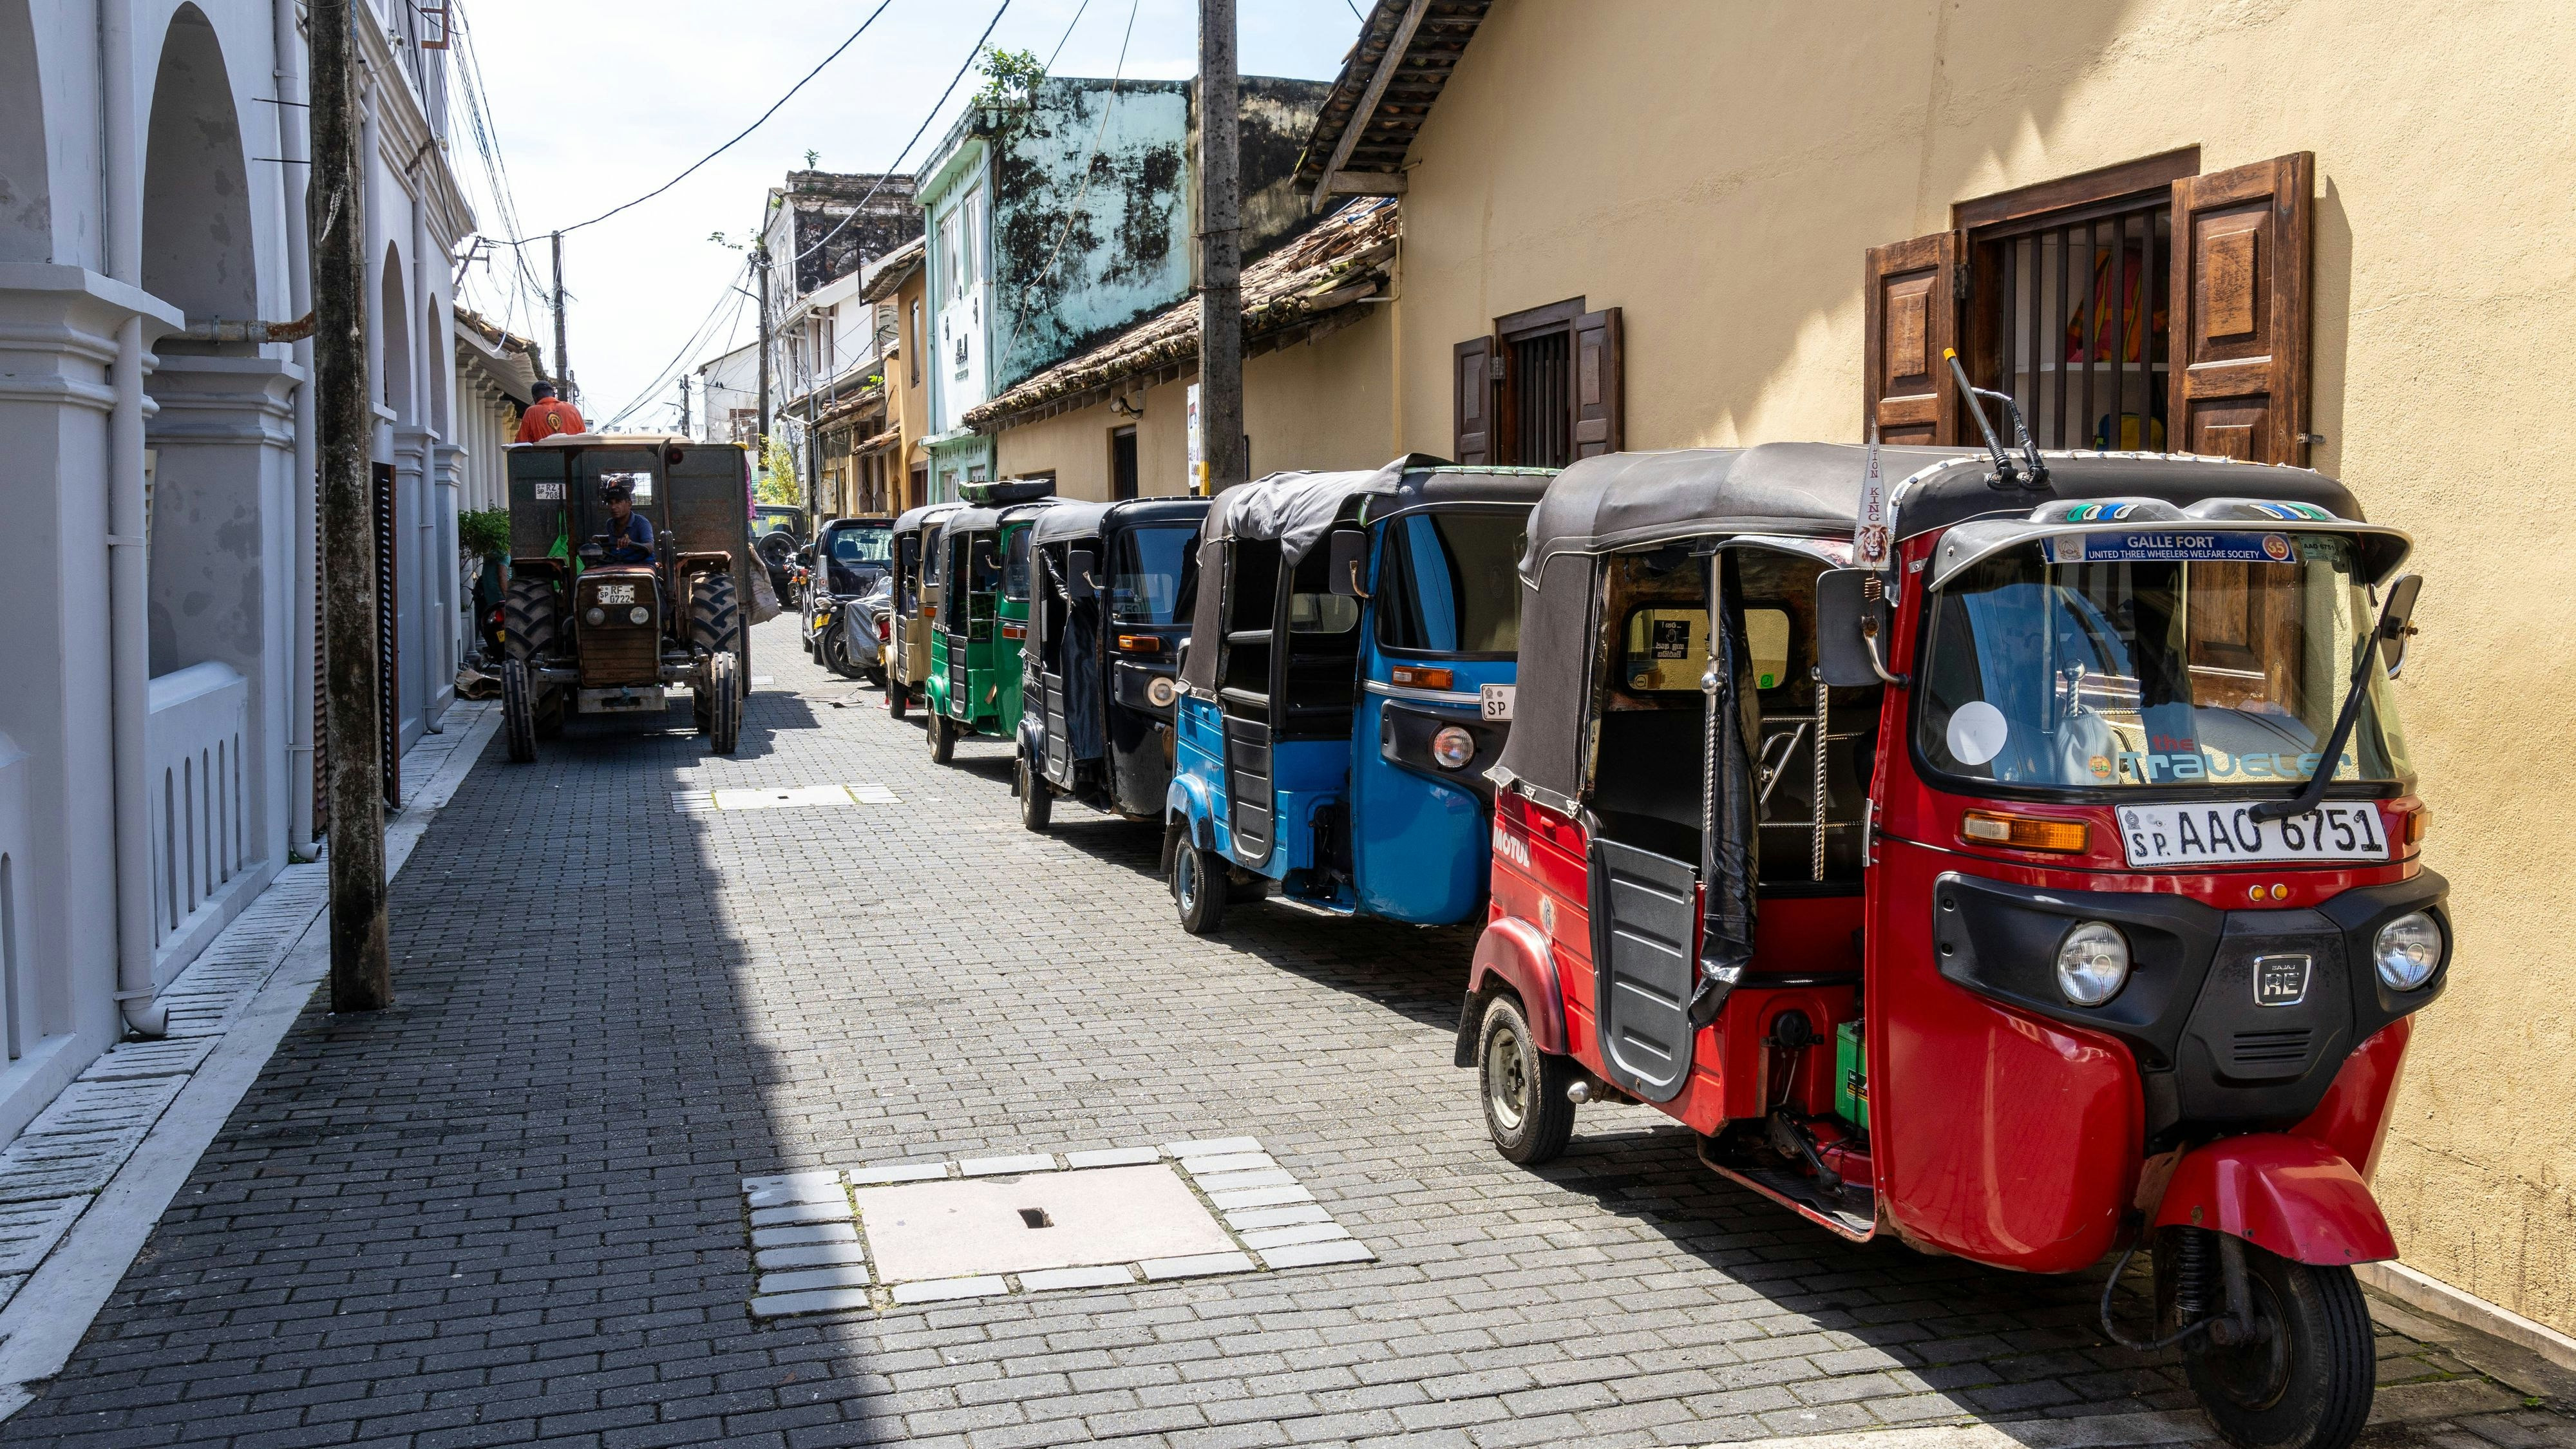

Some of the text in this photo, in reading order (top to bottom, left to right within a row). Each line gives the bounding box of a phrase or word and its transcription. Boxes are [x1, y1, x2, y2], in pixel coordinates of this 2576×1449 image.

[1868, 444, 1880, 521] LION KING
[2127, 536, 2214, 547] GALLE FORT
[2121, 550, 2146, 558] THREE
[2147, 550, 2188, 558] WHEELERS
[2190, 550, 2226, 558] WELFARE
[2228, 551, 2260, 559] SOCIETY
[610, 594, 630, 603] 0722
[1488, 701, 1506, 715] SP
[2152, 734, 2195, 752] the
[2280, 809, 2383, 852] 6751
[1493, 826, 1530, 868] MOTUL
[2264, 972, 2299, 995] RE
